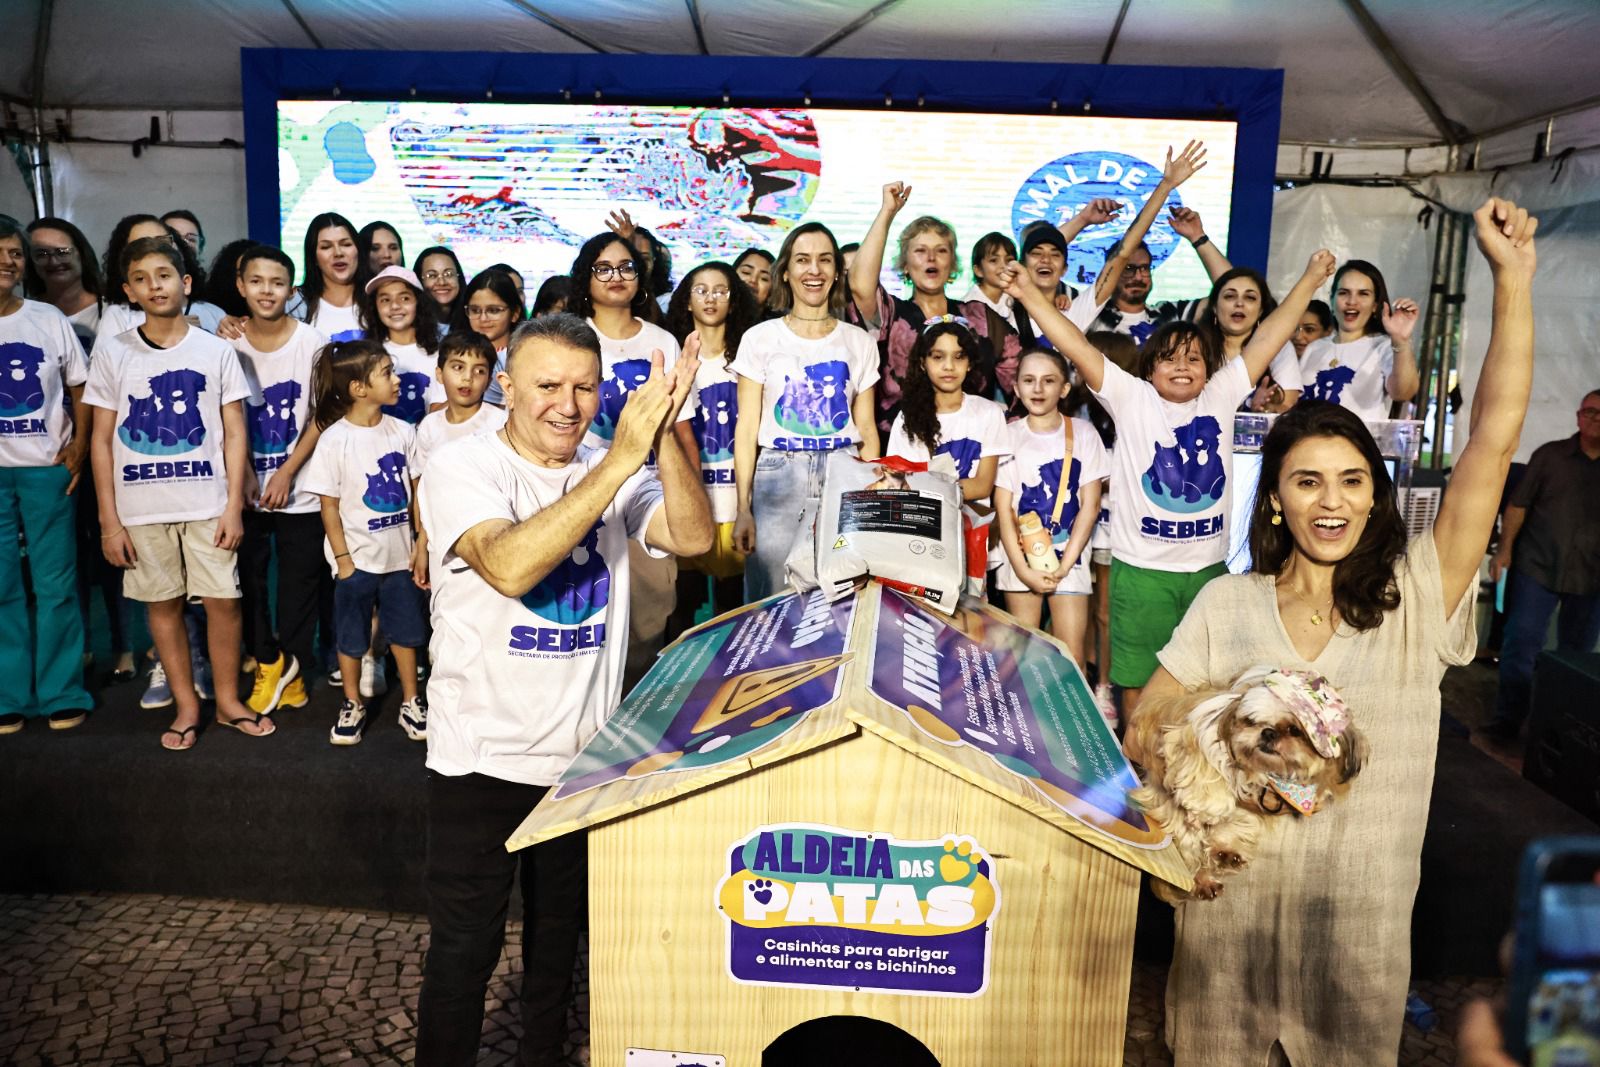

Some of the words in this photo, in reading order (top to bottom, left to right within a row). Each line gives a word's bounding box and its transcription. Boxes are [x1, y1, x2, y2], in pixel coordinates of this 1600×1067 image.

[1097, 160, 1148, 191] DE
[0, 419, 47, 433] BEM
[773, 437, 852, 451] SEBEM
[122, 461, 214, 481] SEBEM
[368, 512, 408, 530] SEBE
[1140, 513, 1224, 538] SEBEM
[896, 612, 944, 711] ATENÇÃO
[967, 709, 980, 726] Esse
[980, 700, 999, 736] Secretaria
[998, 701, 1016, 740] Bem-Estar
[1022, 736, 1036, 754] com
[752, 832, 893, 879] ALDEIA
[899, 860, 934, 878] DAS
[744, 880, 976, 926] PATAS
[764, 938, 840, 954] Casinhas
[844, 944, 882, 957] para
[888, 946, 948, 962] abrigar
[756, 954, 766, 964] e
[770, 954, 850, 969] alimentar
[854, 960, 872, 970] os
[877, 959, 956, 975] bichinhos
